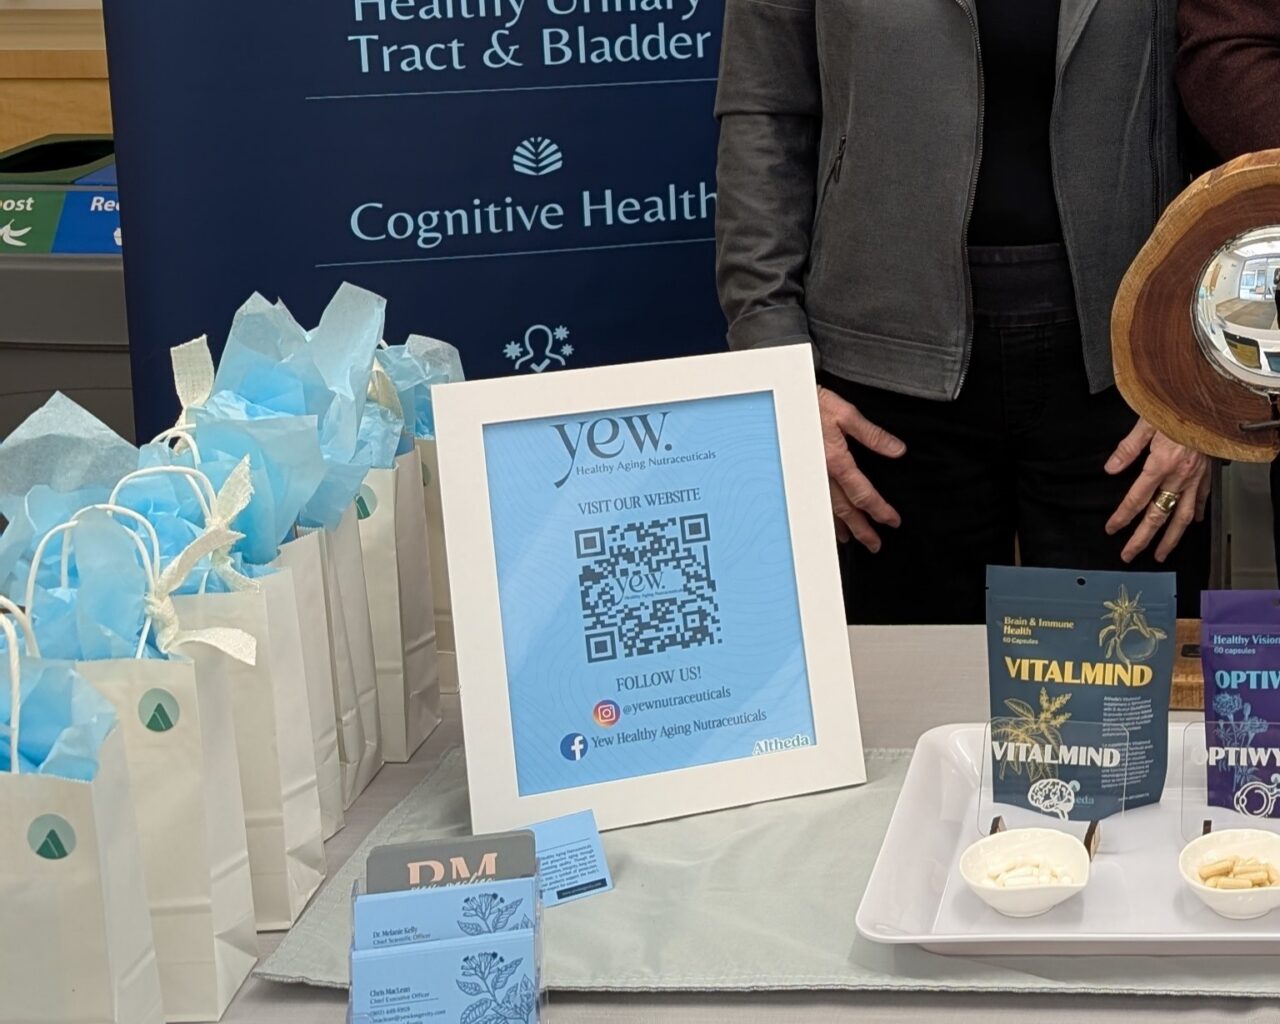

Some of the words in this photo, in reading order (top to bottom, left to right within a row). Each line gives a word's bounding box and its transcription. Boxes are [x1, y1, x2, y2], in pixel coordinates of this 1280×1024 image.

[347, 34, 466, 73] Tract
[483, 29, 524, 68] &
[542, 24, 712, 66] Bladder
[350, 197, 564, 249] Cognitive
[582, 182, 717, 227] Health
[551, 411, 672, 488] yew.
[576, 462, 614, 476] Healthy
[617, 459, 646, 472] Aging
[649, 450, 716, 466] Nutraceuticals
[578, 500, 612, 515] VISIT
[614, 496, 642, 511] OUR
[644, 487, 701, 506] WEBSITE
[1004, 617, 1027, 625] Brain
[1029, 617, 1036, 626] &
[1039, 618, 1074, 629] Immune
[1004, 625, 1031, 635] Health
[1214, 635, 1250, 646] Healthy
[1252, 635, 1280, 645] Vision
[1224, 647, 1256, 655] capsules
[616, 669, 675, 692] FOLLOW
[680, 666, 702, 682] US!
[1004, 656, 1153, 687] VITALMIND
[623, 686, 731, 715] @yewnutraceuticals
[591, 735, 615, 749] Yew
[617, 727, 657, 745] Healthy
[659, 721, 691, 738] Aging
[693, 709, 767, 731] Nutraceuticals
[753, 735, 809, 754] Altheda
[991, 741, 1121, 767] VITALMIND
